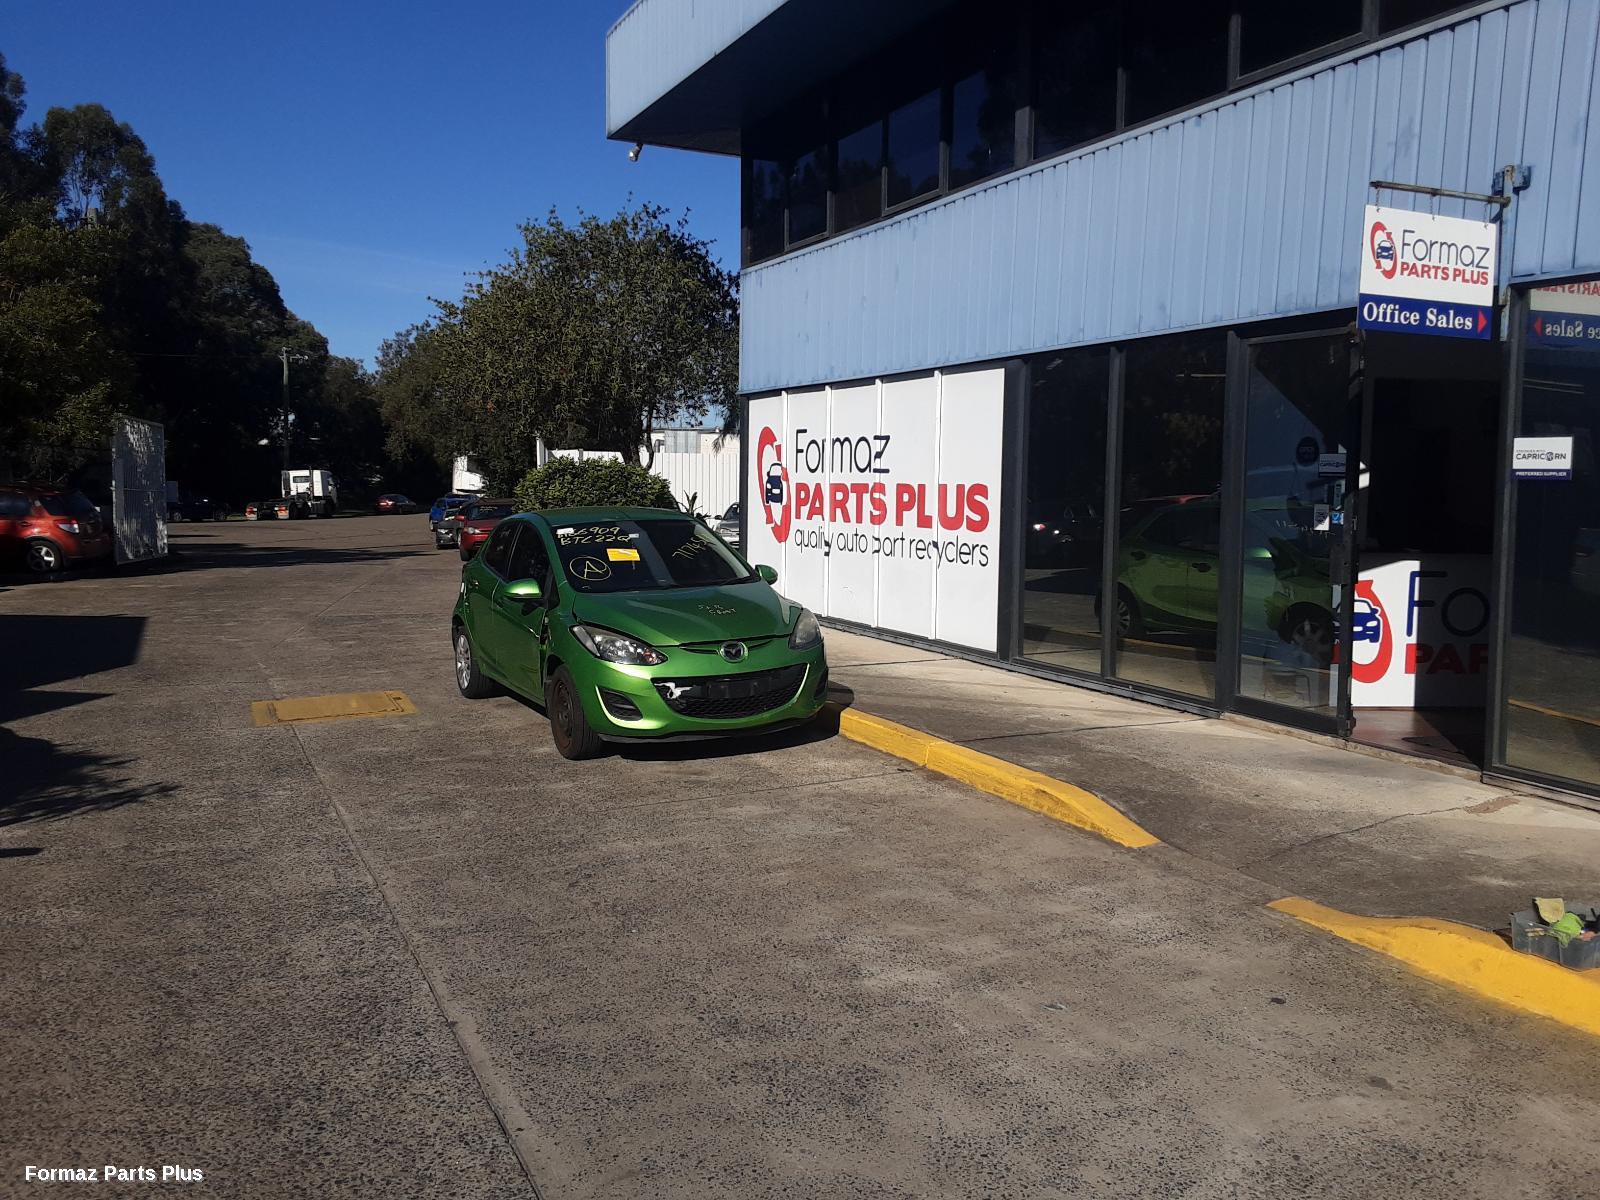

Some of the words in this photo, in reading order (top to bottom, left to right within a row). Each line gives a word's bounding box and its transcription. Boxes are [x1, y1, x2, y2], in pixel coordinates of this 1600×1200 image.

[1401, 229, 1490, 270] Formaz
[1400, 262, 1449, 281] PARTS
[1452, 268, 1489, 286] PLUS
[1363, 302, 1420, 326] Office
[1425, 308, 1473, 331] Sales
[795, 428, 891, 474] Formaz
[795, 482, 888, 526] PARTS
[895, 483, 990, 533] PLUS
[836, 527, 868, 554] auto
